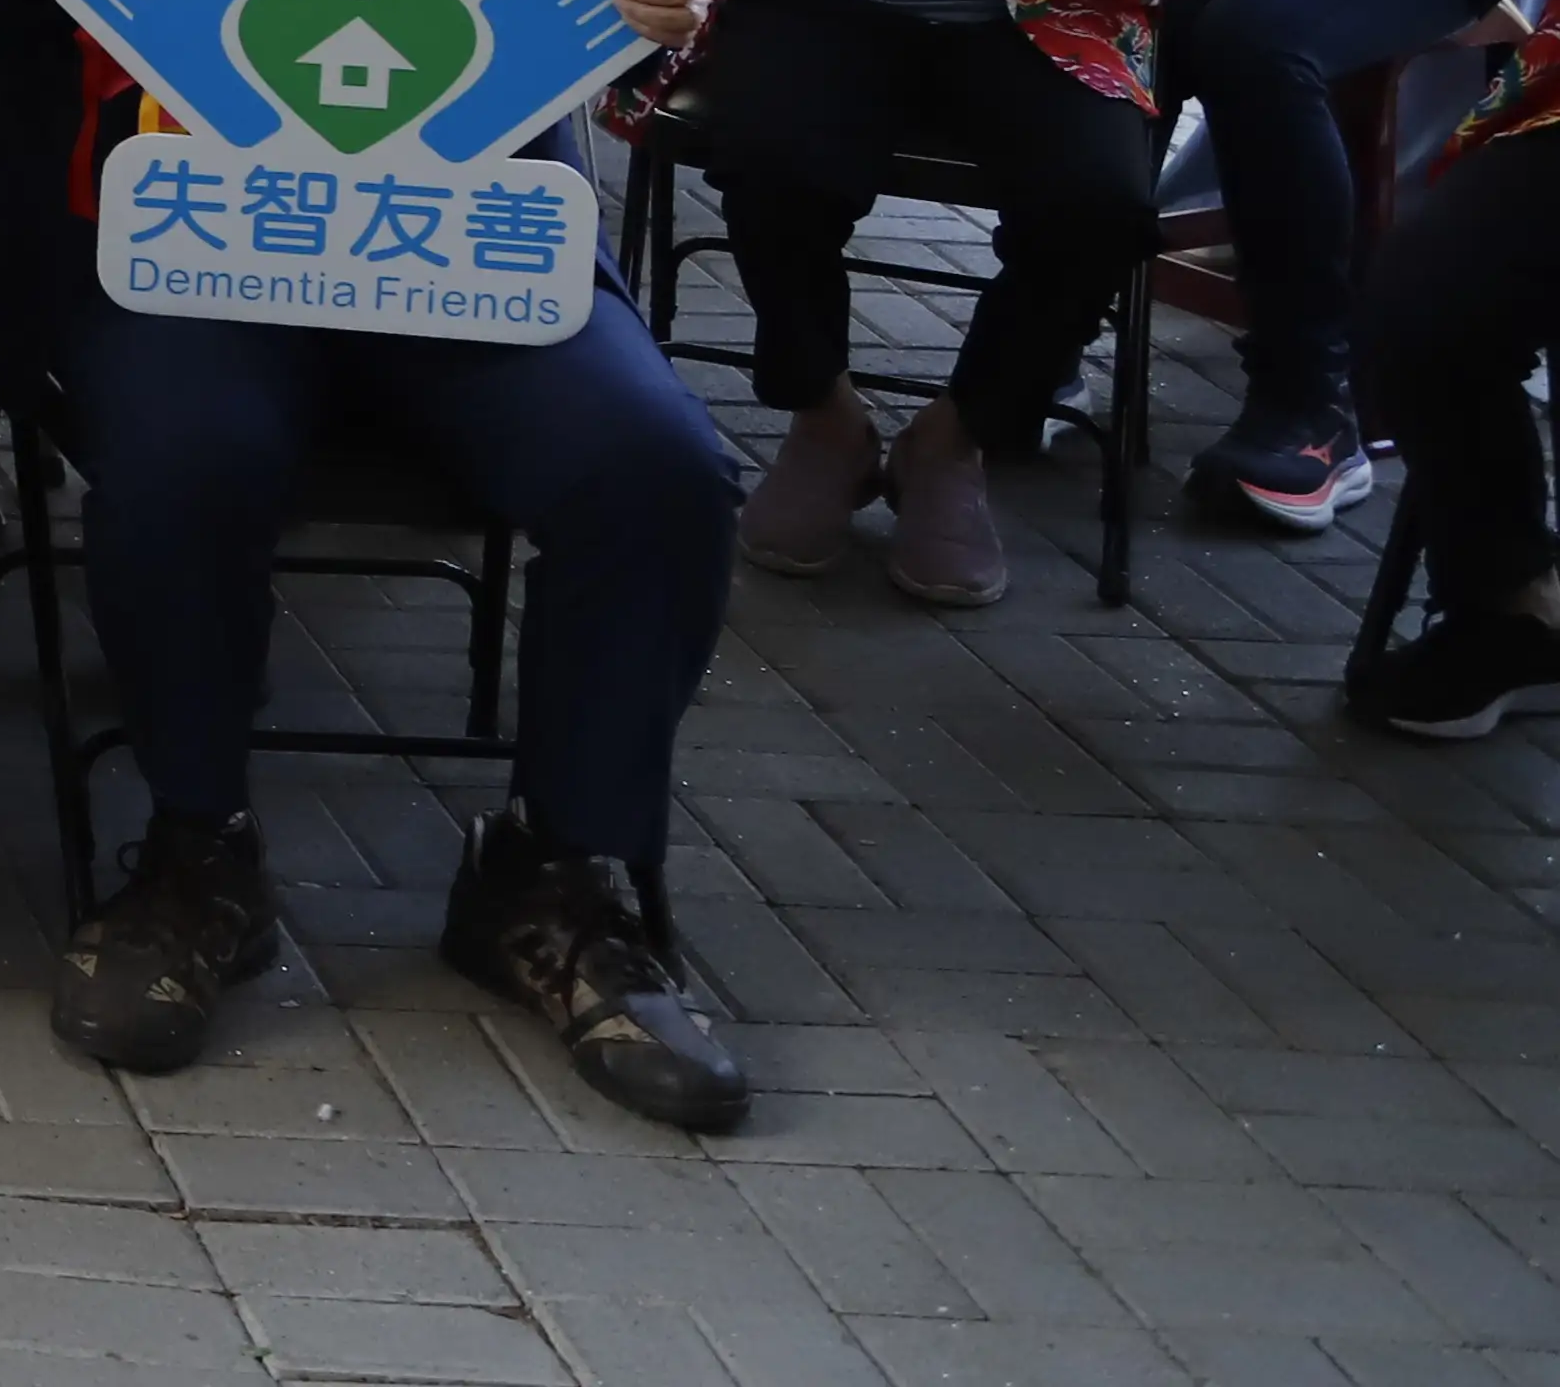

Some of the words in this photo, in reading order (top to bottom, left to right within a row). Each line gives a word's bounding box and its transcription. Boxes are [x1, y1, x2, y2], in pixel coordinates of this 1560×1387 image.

[130, 159, 568, 277] 失智友善
[128, 256, 358, 310] Dementia
[374, 274, 562, 326] Friends
